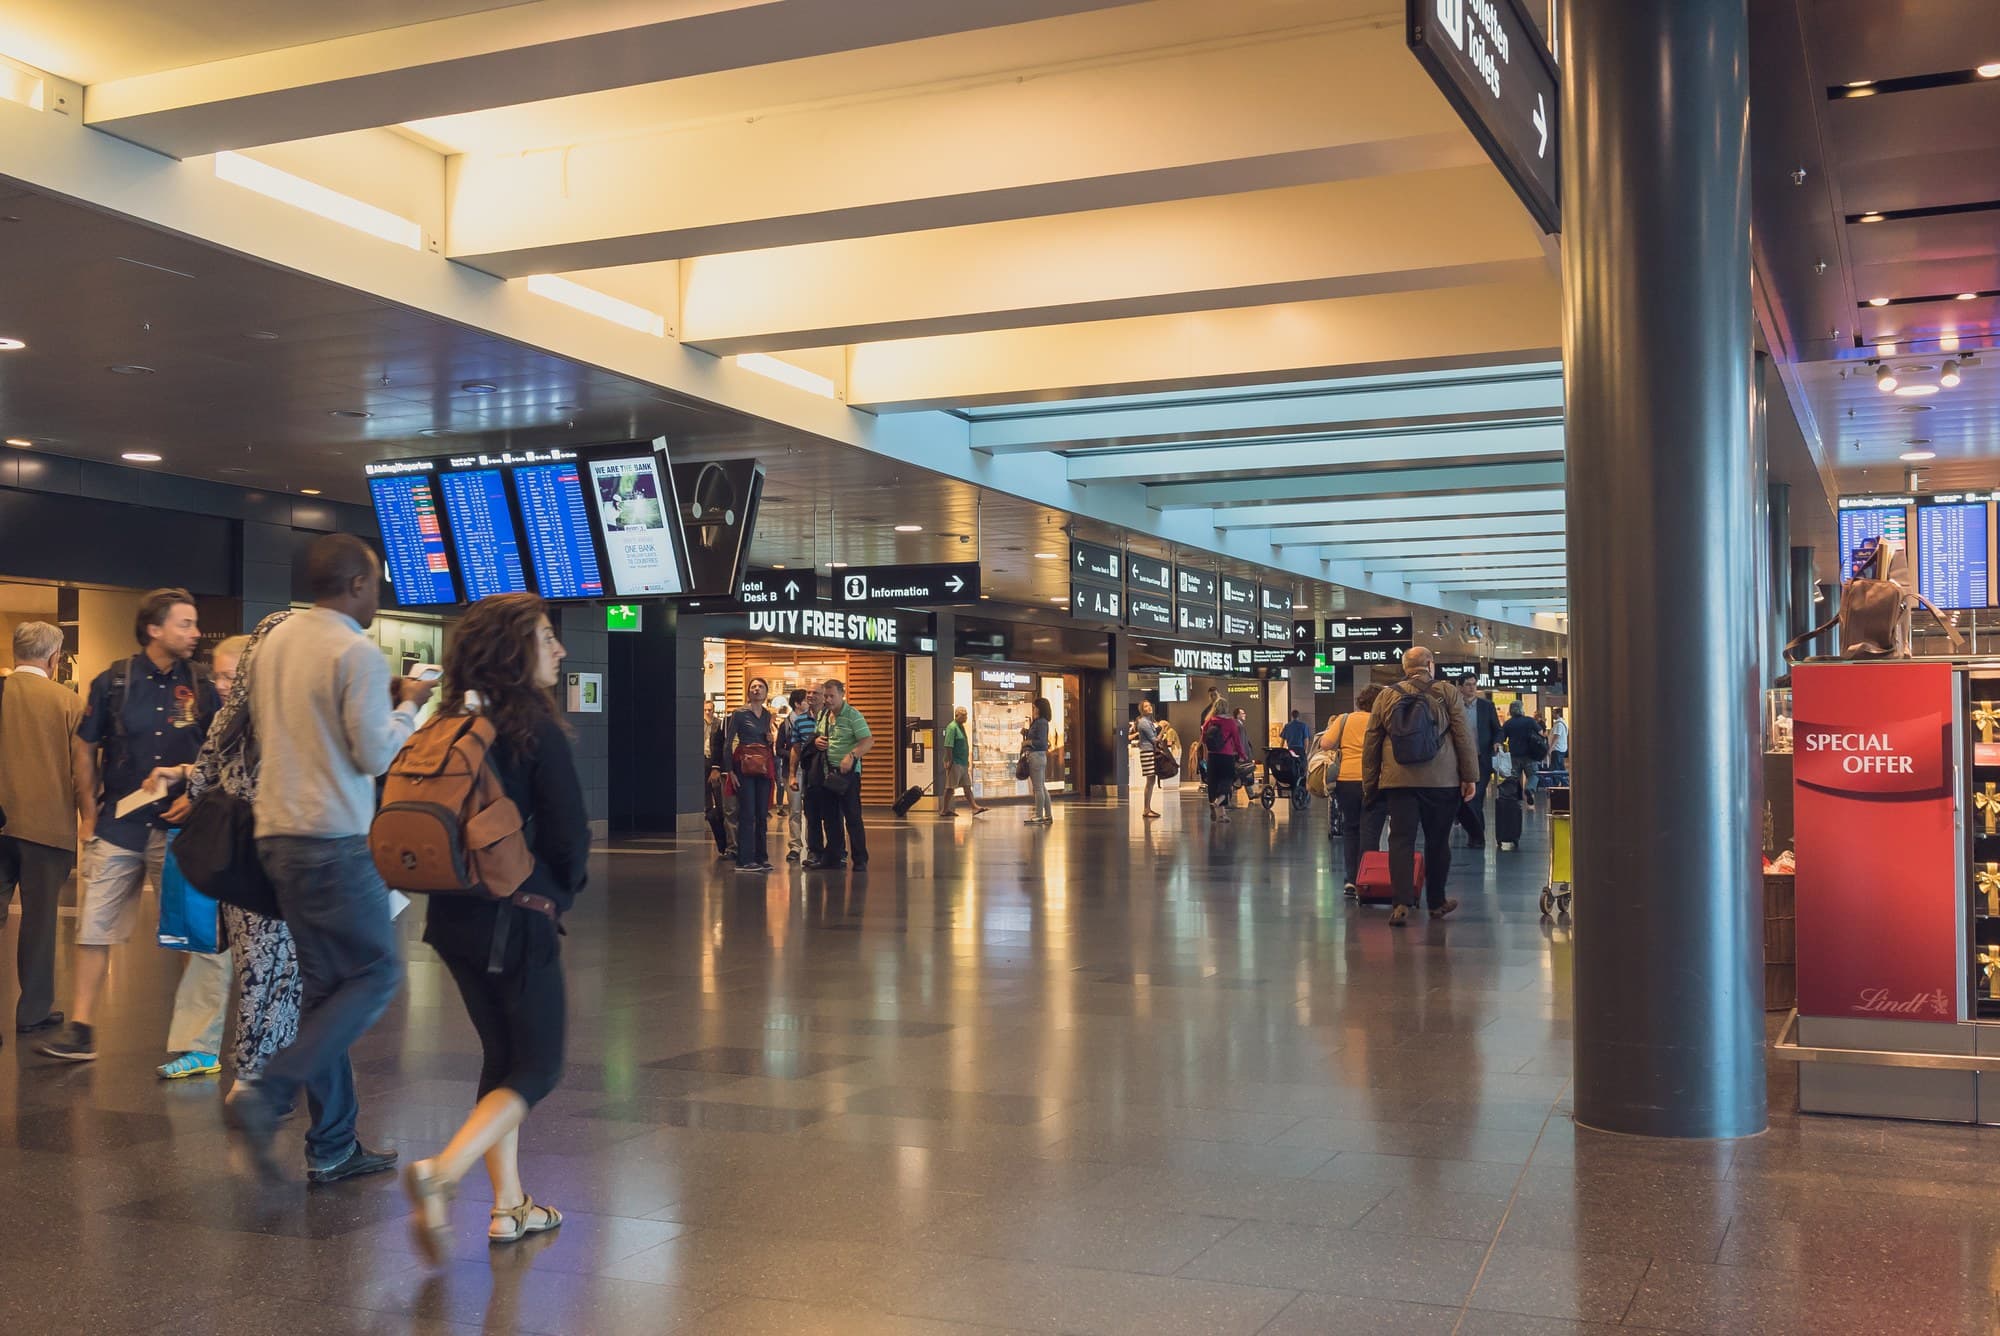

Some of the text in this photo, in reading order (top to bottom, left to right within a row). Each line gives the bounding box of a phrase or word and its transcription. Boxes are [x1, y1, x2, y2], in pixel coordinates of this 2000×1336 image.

[1468, 0, 1508, 64] iletten
[1467, 15, 1500, 98] Toilets
[595, 466, 606, 474] WE
[607, 465, 622, 473] ARE
[634, 463, 652, 471] BANK
[744, 591, 778, 602] Desk B
[871, 586, 929, 598] Information
[1094, 592, 1102, 612] A
[749, 609, 897, 643] DUTY FREE STORE
[1174, 648, 1199, 669] DUTY
[1201, 651, 1223, 670] FREE
[1806, 733, 1893, 751] SPECIAL
[1843, 756, 1913, 774] OFFER
[1852, 988, 1930, 1013] Lindt
